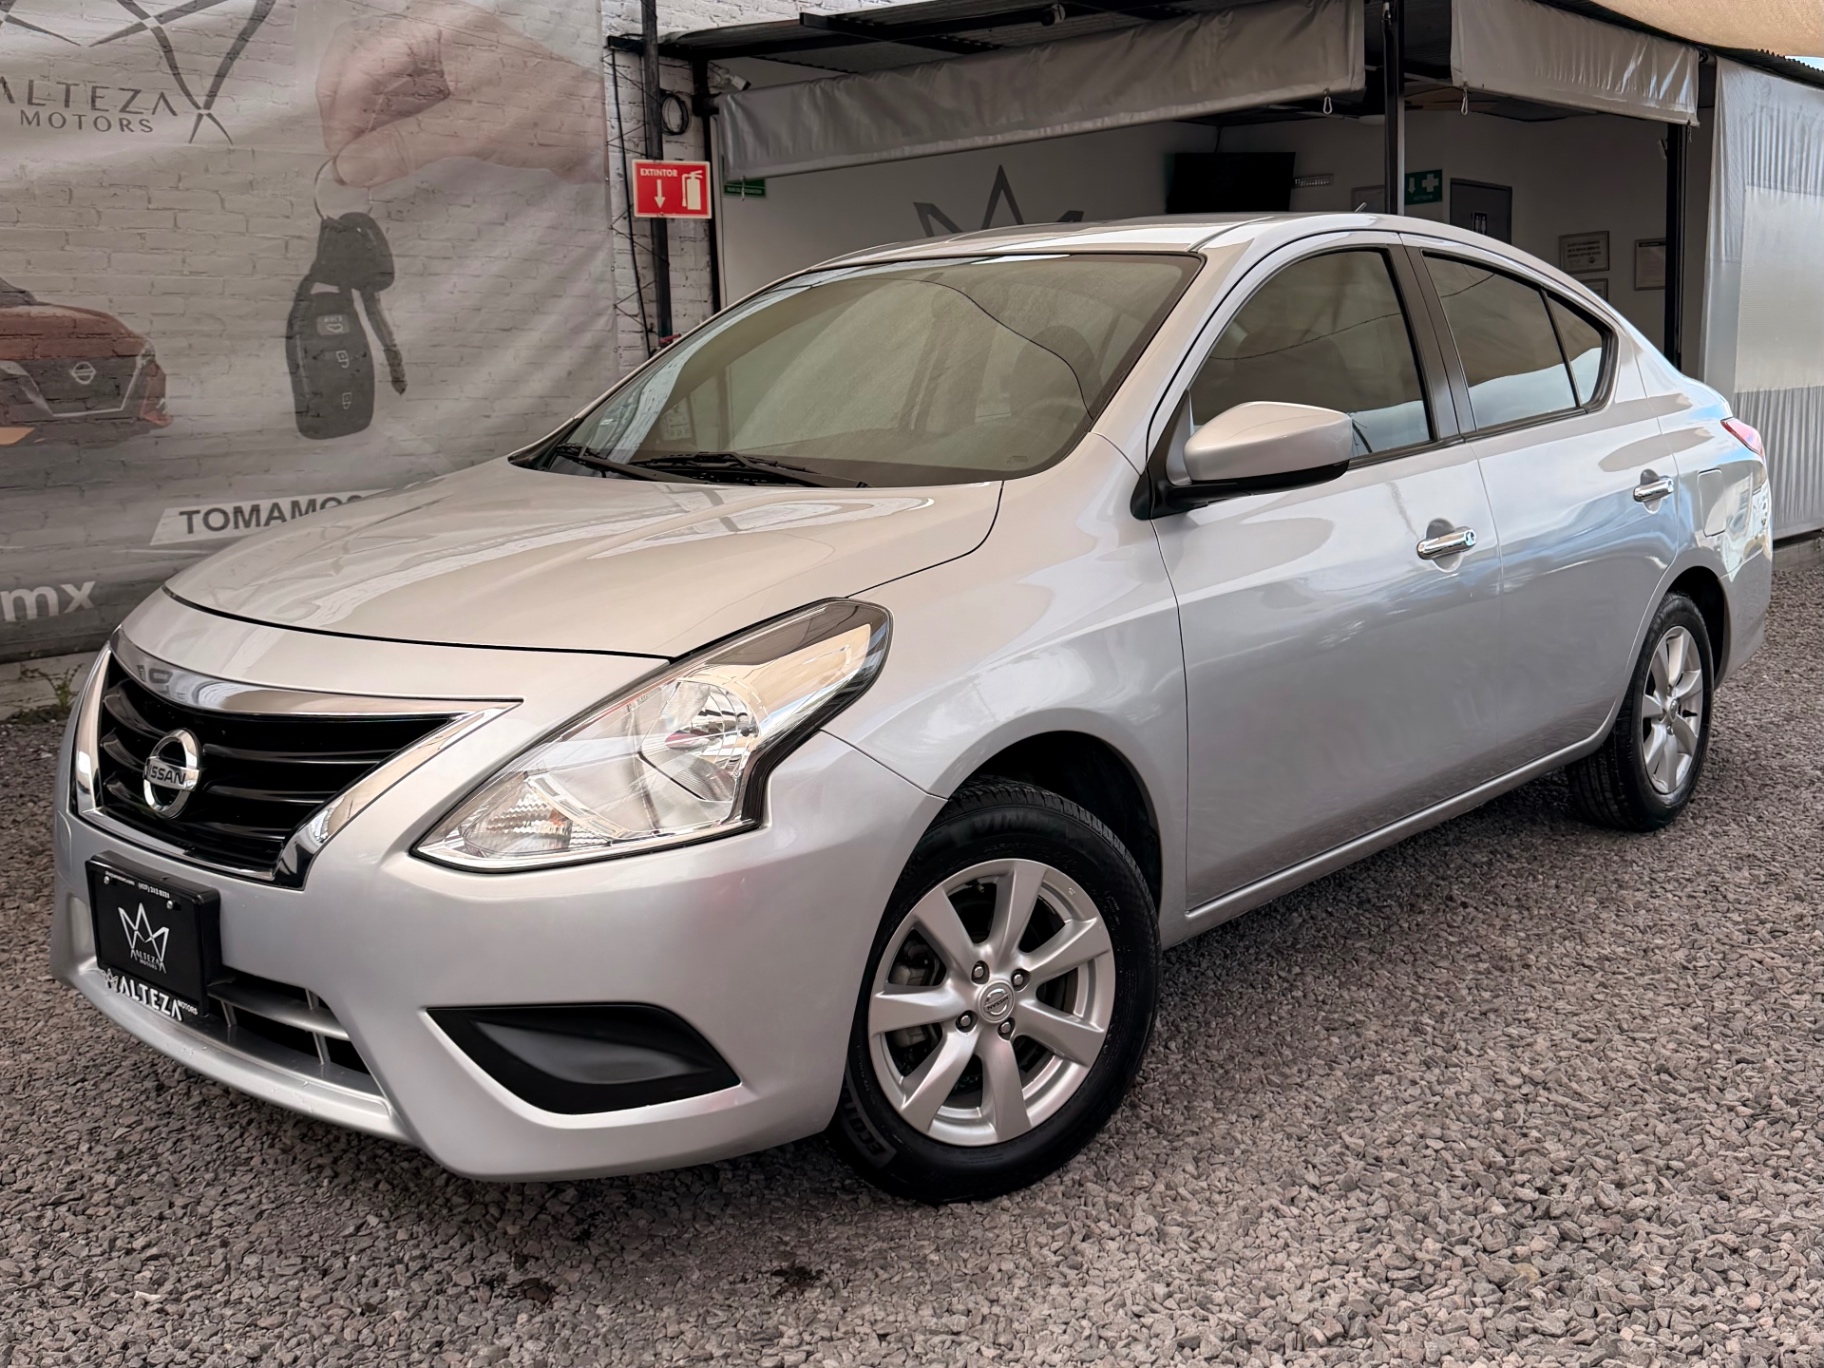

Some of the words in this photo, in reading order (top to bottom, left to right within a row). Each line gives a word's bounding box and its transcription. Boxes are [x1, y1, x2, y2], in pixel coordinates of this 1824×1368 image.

[20, 109, 154, 133] MOTORS
[640, 167, 678, 178] EXTINTOR
[179, 494, 363, 534] TOMAM
[119, 975, 183, 1022] ALTEZA
